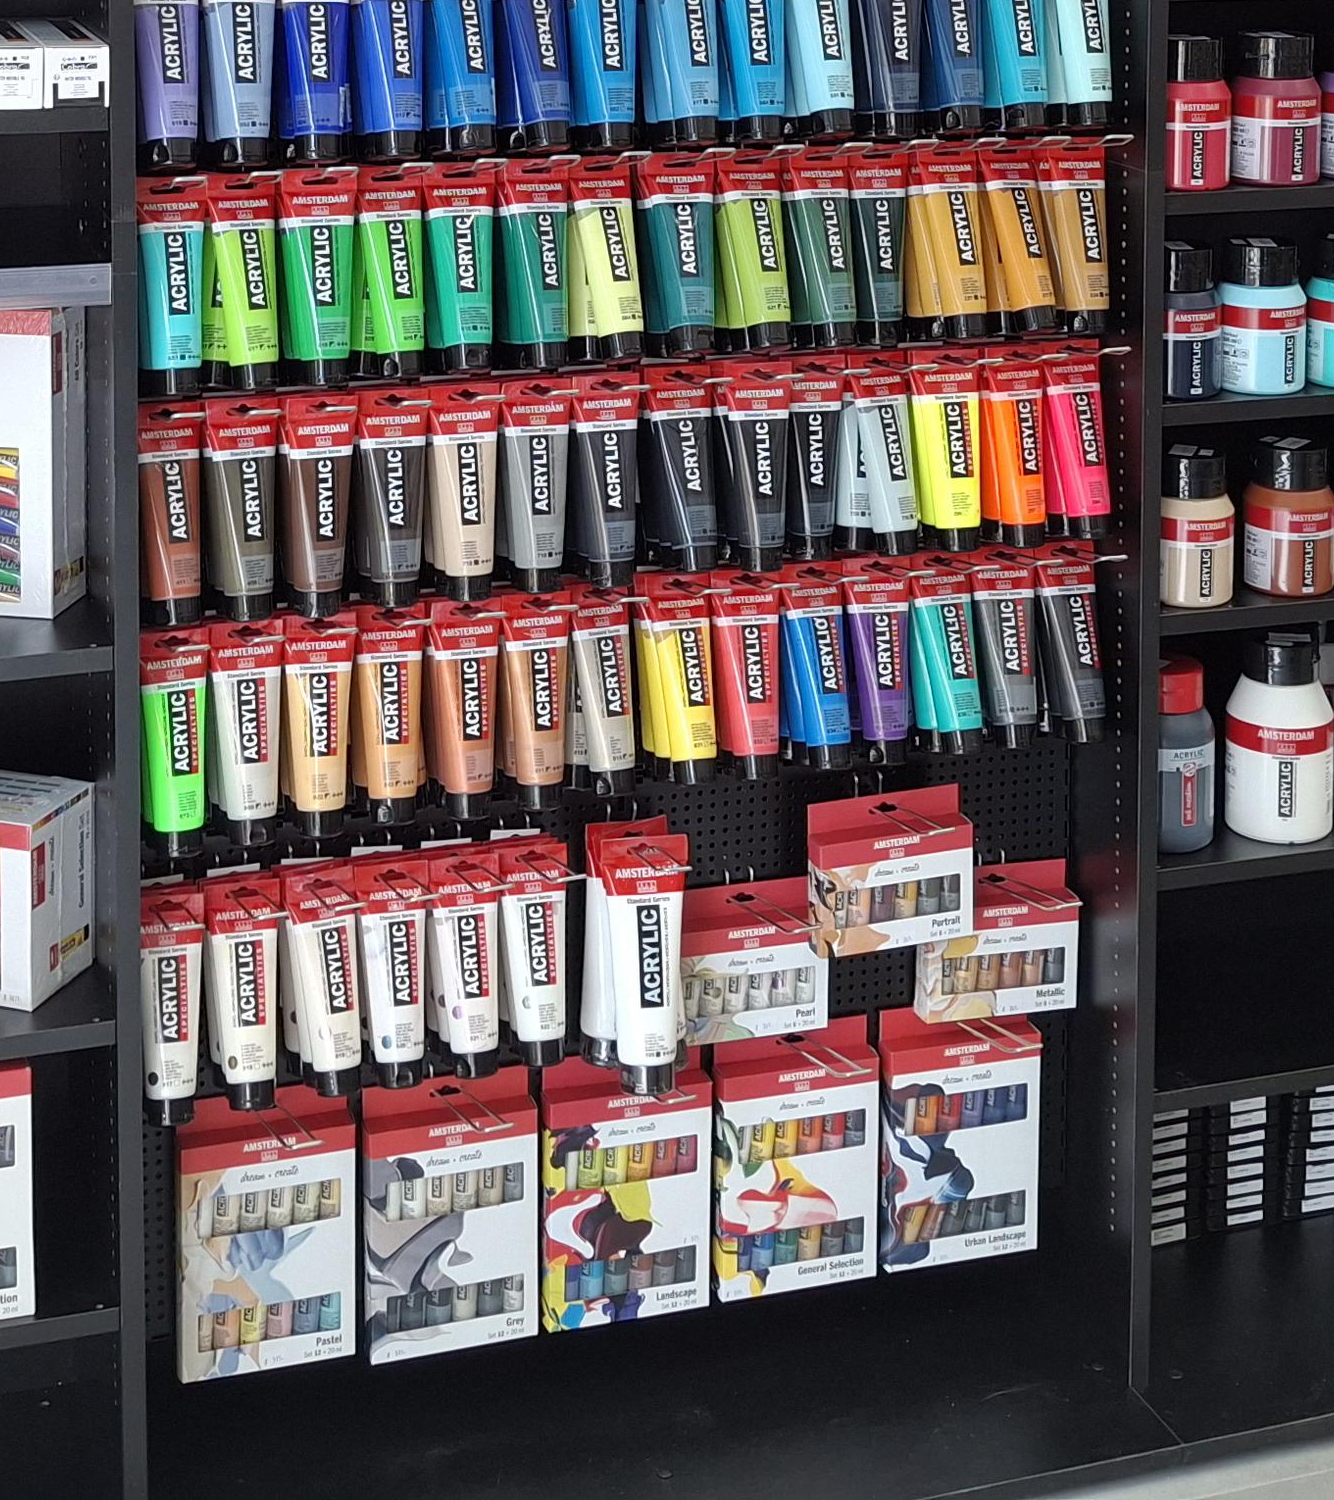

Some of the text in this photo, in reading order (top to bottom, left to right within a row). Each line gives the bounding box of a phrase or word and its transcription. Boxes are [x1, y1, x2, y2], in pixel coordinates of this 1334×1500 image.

[311, 4, 328, 79] ACRYLIC
[682, 203, 698, 276] ACRYLIC
[169, 235, 186, 312] ACRYLIC
[952, 403, 966, 475] ACRYLIC
[534, 437, 549, 512] ACRYLIC
[241, 680, 257, 762] ACRYLIC
[259, 683, 267, 762] SPECIALTIES
[172, 692, 190, 772] ACRYLIC
[189, 696, 198, 773] SPECIALTIES
[1257, 729, 1315, 742] AMSTERDAM
[1173, 749, 1205, 760] ACRYLIC
[1279, 762, 1292, 816] ACRYLIC
[874, 836, 920, 850] AMSTERDAM
[983, 906, 1029, 918] AMSTERDAM
[931, 916, 961, 929] Portrait
[728, 926, 776, 940] AMSTERDAM
[641, 907, 659, 1004] ACRYLIC
[162, 957, 178, 1040] ACRYLIC
[1036, 987, 1066, 998] Metallic
[795, 1008, 815, 1018] Pearl
[944, 1044, 990, 1057] AMSTERDAM
[964, 1229, 1027, 1248] Urban Landscape
[797, 1256, 864, 1276] General Selection
[656, 1286, 697, 1302] Landscape
[506, 1315, 525, 1328] Grey
[316, 1334, 343, 1347] Pastel
